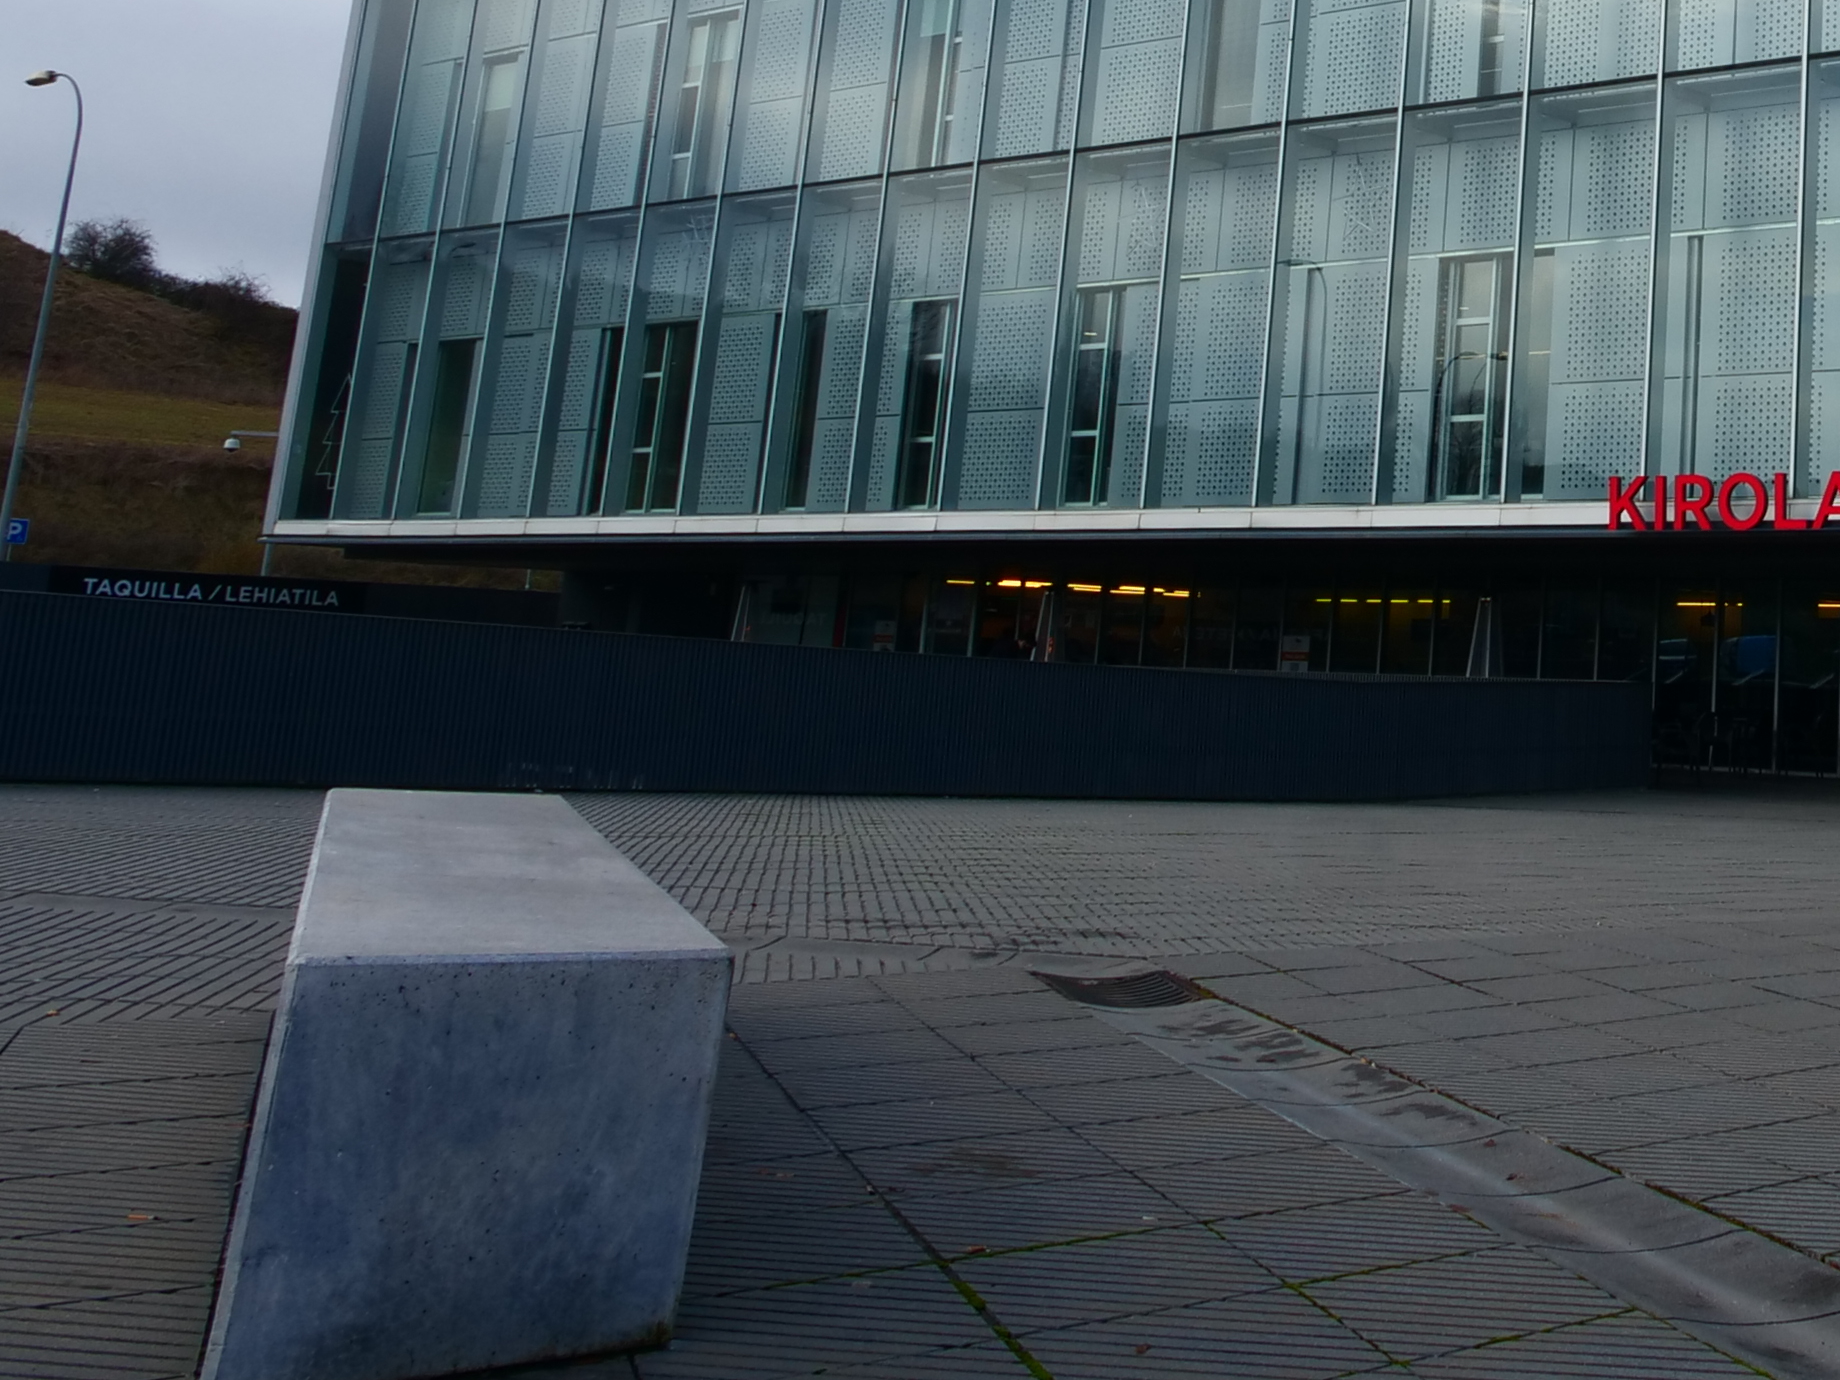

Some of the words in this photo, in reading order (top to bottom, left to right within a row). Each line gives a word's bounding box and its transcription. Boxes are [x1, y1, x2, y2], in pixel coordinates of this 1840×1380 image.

[7, 522, 22, 540] P
[84, 578, 202, 600] TAQUILLA
[225, 586, 339, 606] LEHIATILA
